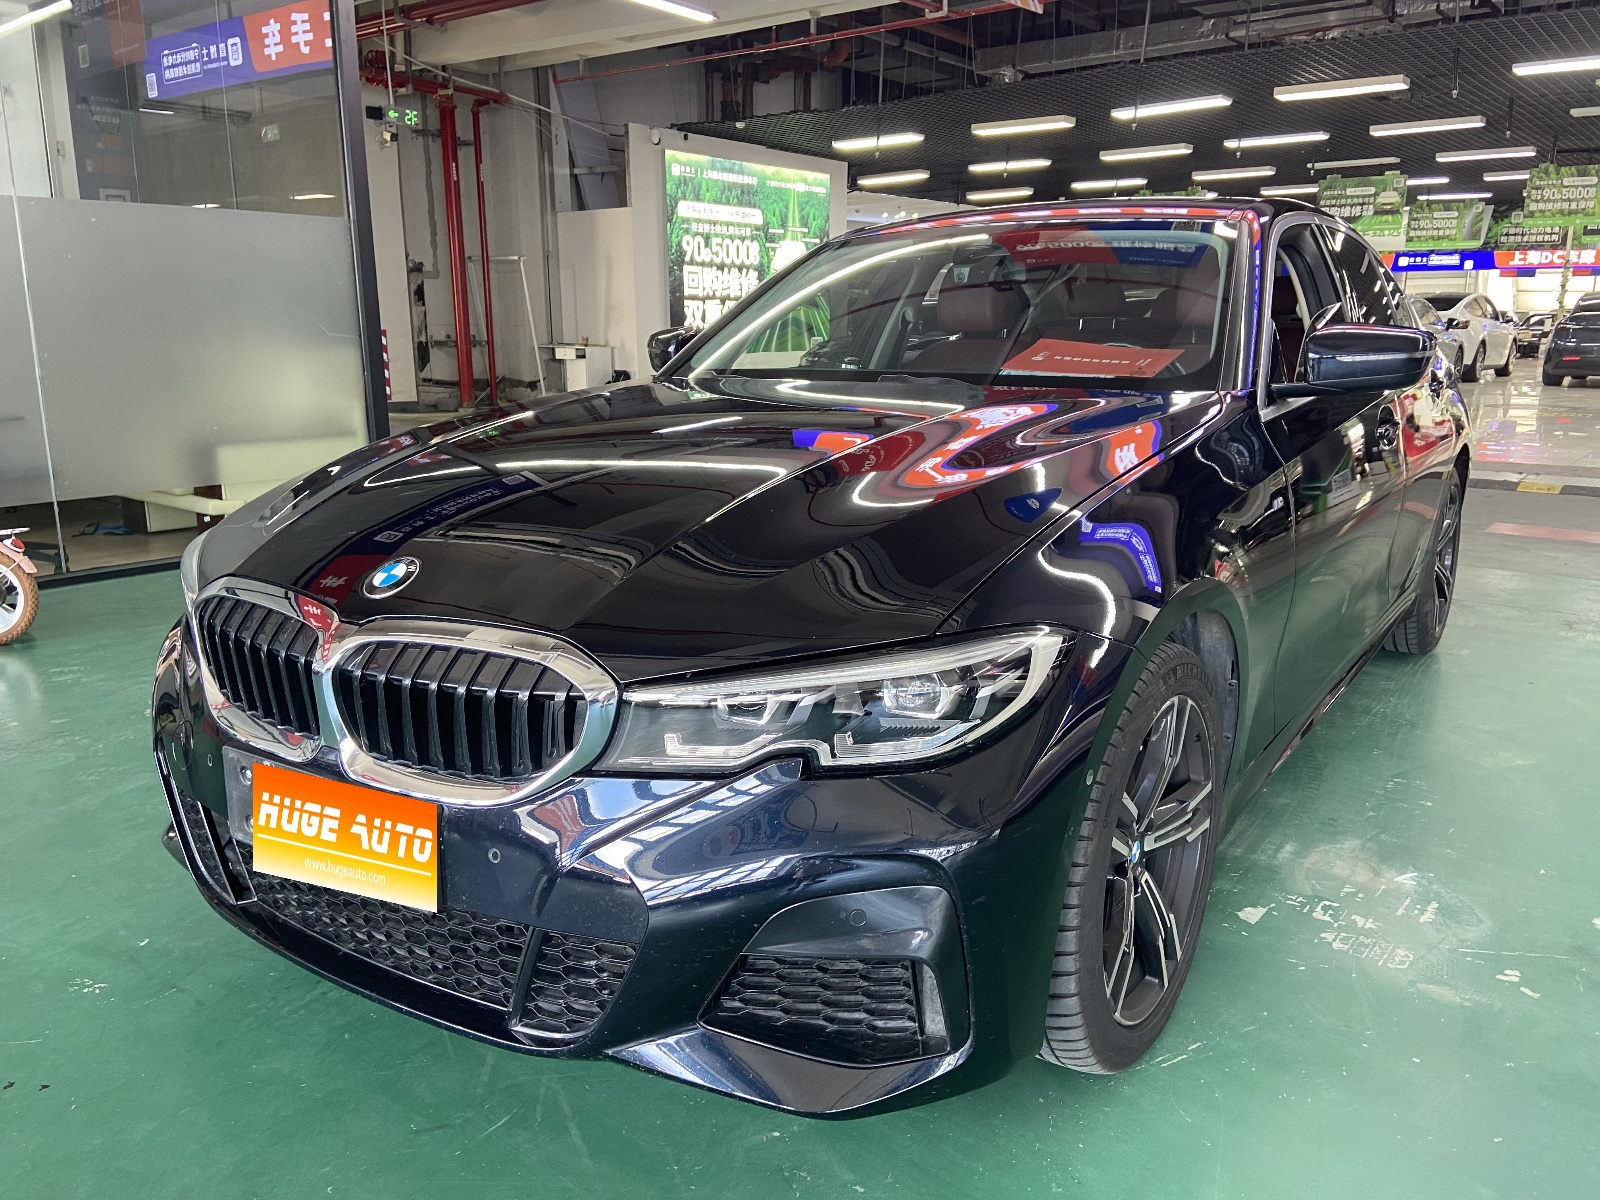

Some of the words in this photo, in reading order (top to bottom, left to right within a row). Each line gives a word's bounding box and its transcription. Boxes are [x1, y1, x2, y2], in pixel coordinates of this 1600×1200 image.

[404, 109, 418, 126] 2F
[683, 265, 759, 298] 回购维修
[683, 299, 741, 330] 双重
